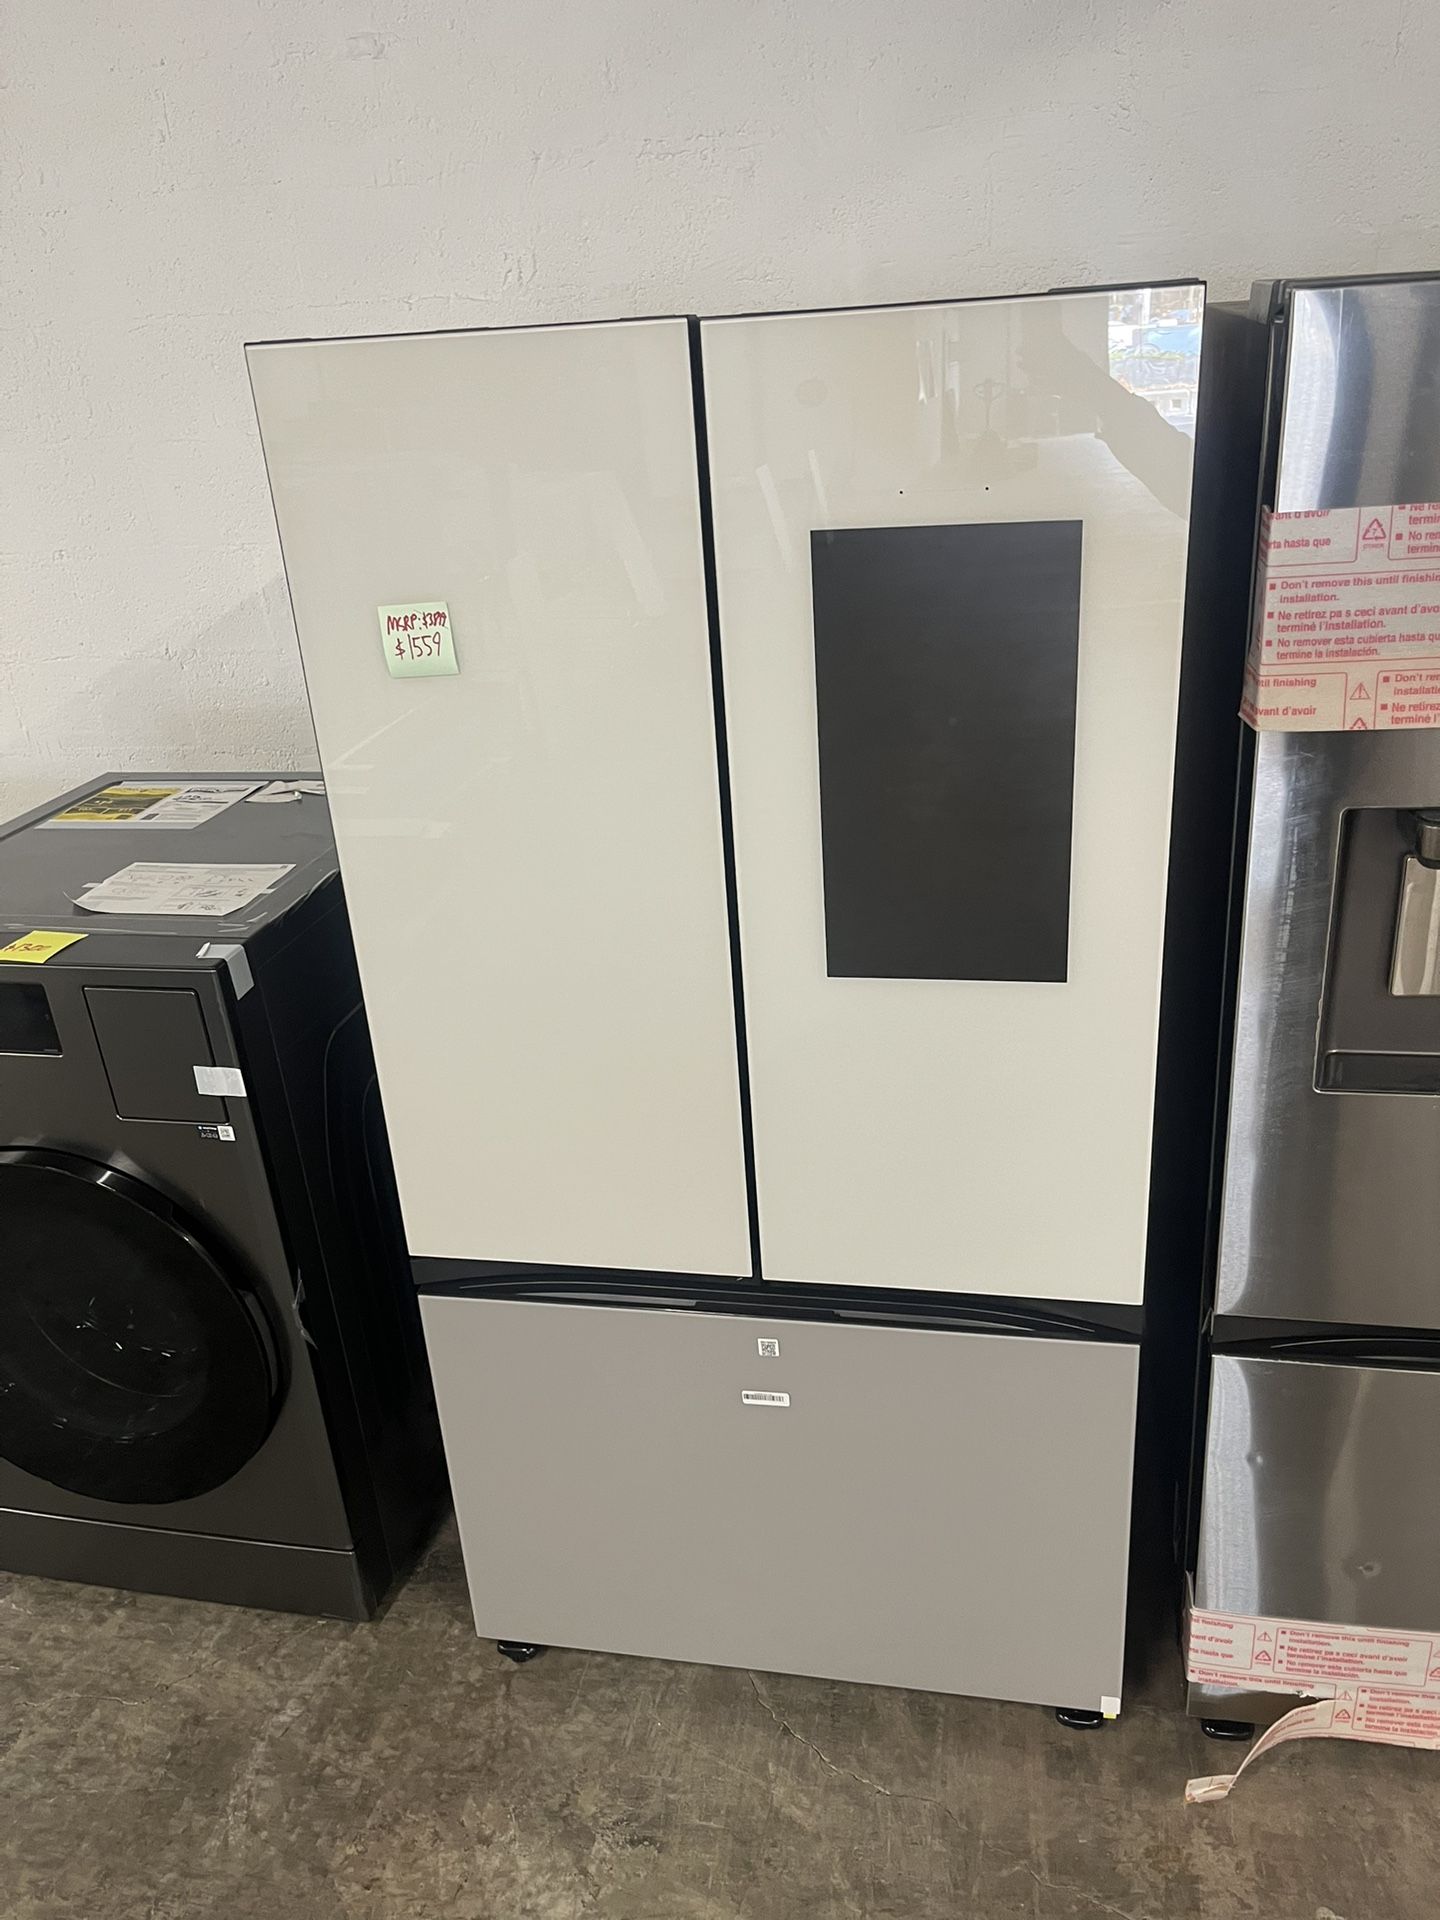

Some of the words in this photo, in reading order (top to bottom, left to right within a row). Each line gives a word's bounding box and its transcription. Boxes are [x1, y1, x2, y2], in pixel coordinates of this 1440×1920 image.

[1408, 531, 1422, 541] No
[1284, 538, 1310, 548] hasta
[1312, 538, 1332, 549] que
[1281, 580, 1308, 589] Don't
[1311, 579, 1350, 588] remove
[1353, 577, 1372, 586] this
[1376, 575, 1399, 584] until
[1280, 593, 1340, 603] installation.
[1278, 611, 1291, 620] Ne
[1295, 610, 1327, 619] retirez
[1354, 606, 1376, 616] ceci
[1378, 606, 1407, 616] avant
[395, 631, 441, 660] $1559
[1277, 639, 1290, 648] No
[1293, 639, 1332, 647] remover
[1334, 635, 1354, 645] esta
[1357, 634, 1396, 644] cubierta
[1399, 633, 1425, 643] hasta
[1276, 650, 1312, 660] termine
[1315, 648, 1324, 658] la
[1273, 677, 1317, 688] finishing
[1394, 673, 1423, 682] Don't
[1282, 705, 1317, 716] d'avoir
[1392, 702, 1406, 712] Ne
